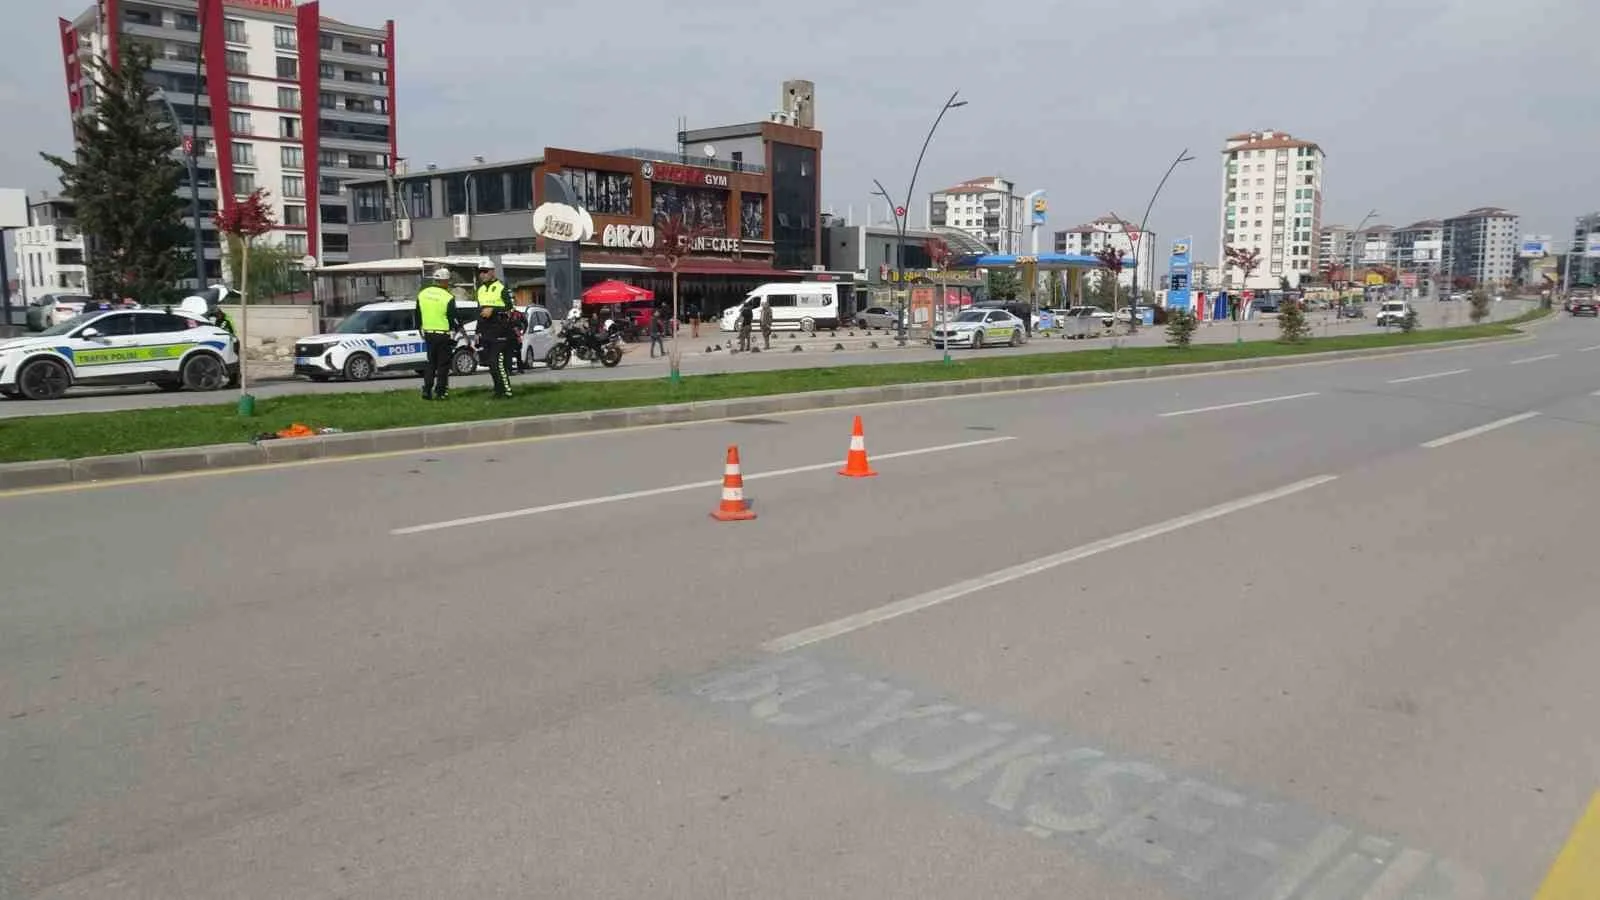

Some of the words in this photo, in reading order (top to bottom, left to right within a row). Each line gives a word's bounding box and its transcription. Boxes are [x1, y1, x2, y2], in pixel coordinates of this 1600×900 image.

[705, 174, 728, 187] GYM
[540, 214, 574, 237] Arzu
[603, 224, 655, 248] ARZU
